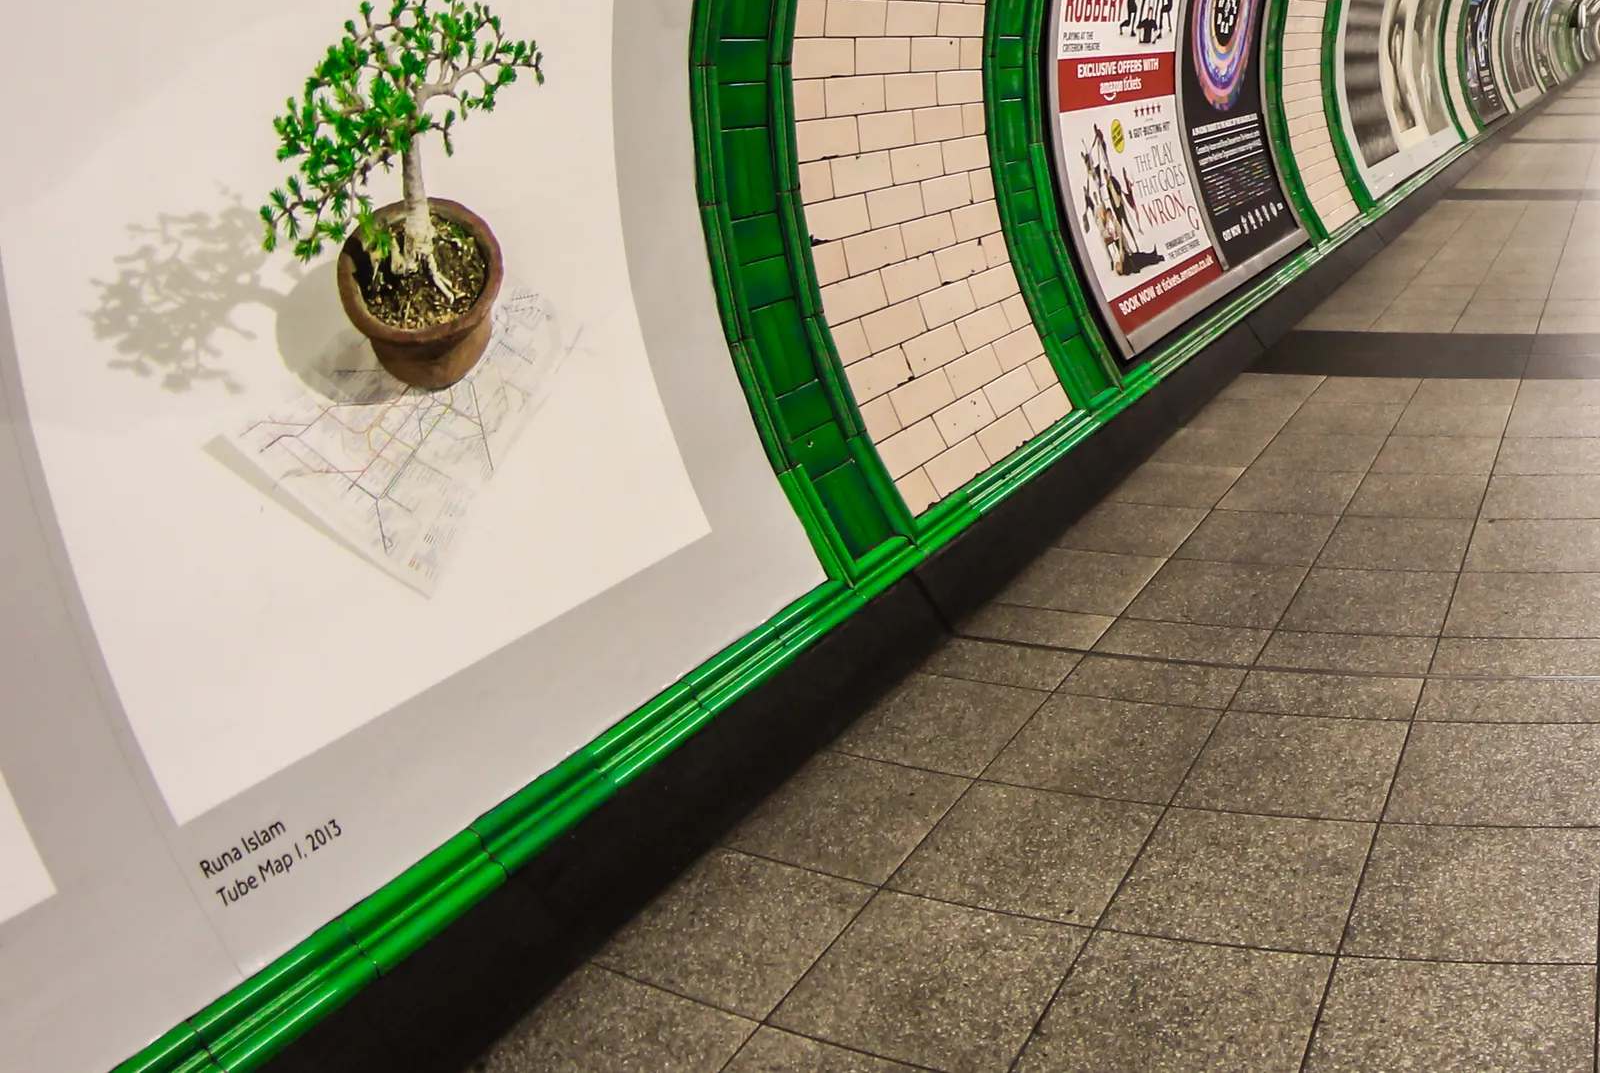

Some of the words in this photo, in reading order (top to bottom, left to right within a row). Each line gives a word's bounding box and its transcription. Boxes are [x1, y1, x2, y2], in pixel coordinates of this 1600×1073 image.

[1077, 61, 1116, 78] EXCLUSIVE
[1117, 59, 1142, 74] OFFERS
[1143, 57, 1159, 72] WITH
[1100, 79, 1123, 95] amazon
[1123, 74, 1142, 91] tickets
[1134, 153, 1155, 173] THE
[1151, 141, 1174, 169] PLAY
[1135, 175, 1160, 198] THAT
[1157, 163, 1186, 192] GOES
[1142, 190, 1200, 231] WRONG
[1118, 294, 1141, 315] BOOK
[1138, 286, 1156, 305] NOW
[1155, 282, 1164, 296] at
[199, 847, 243, 879] Runa
[241, 820, 287, 854] Islam
[216, 875, 259, 907] Tube
[257, 853, 293, 882] Map
[305, 818, 342, 852] 2013
